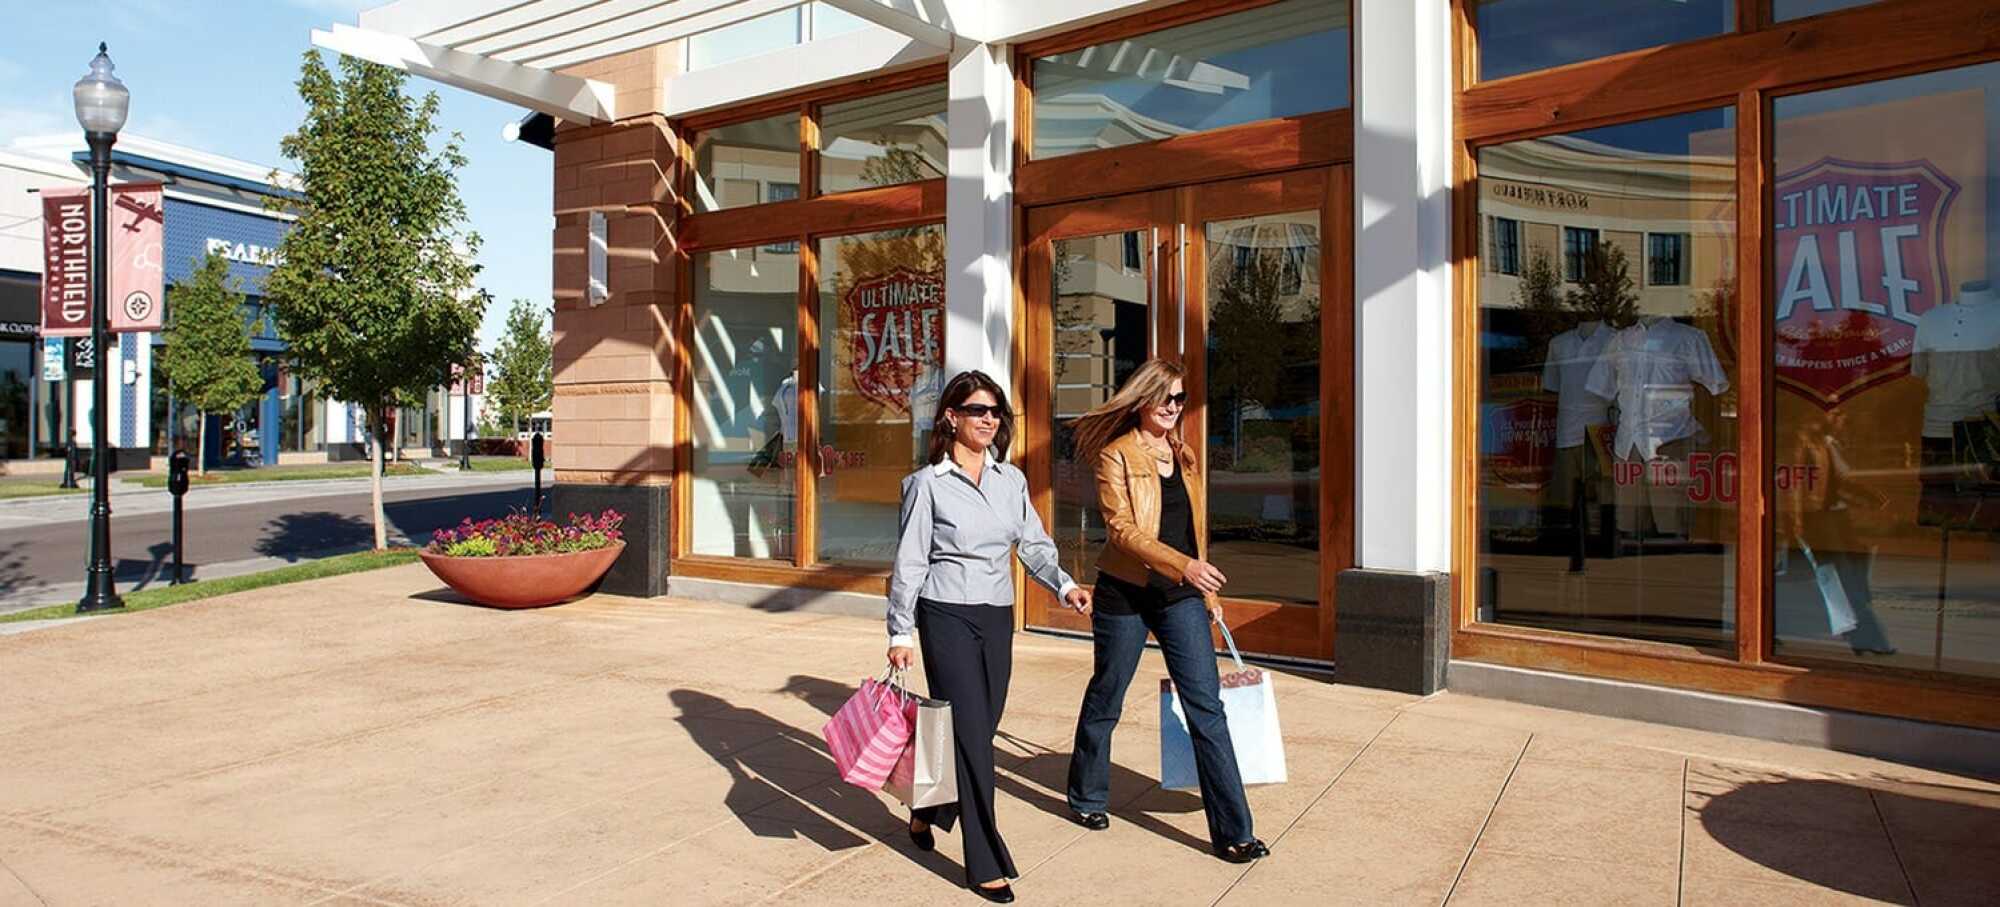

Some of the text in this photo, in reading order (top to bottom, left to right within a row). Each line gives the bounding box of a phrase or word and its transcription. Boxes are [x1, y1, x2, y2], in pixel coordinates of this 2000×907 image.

[1775, 183, 1919, 229] TIMATE
[60, 203, 87, 323] NORTHFIELD
[1775, 223, 1922, 329] ALE
[861, 283, 939, 309] ULTIMATE
[859, 307, 939, 374] SALE
[1835, 354, 1868, 369] TWICE
[1614, 452, 1820, 503] UP TO 50 OFF
